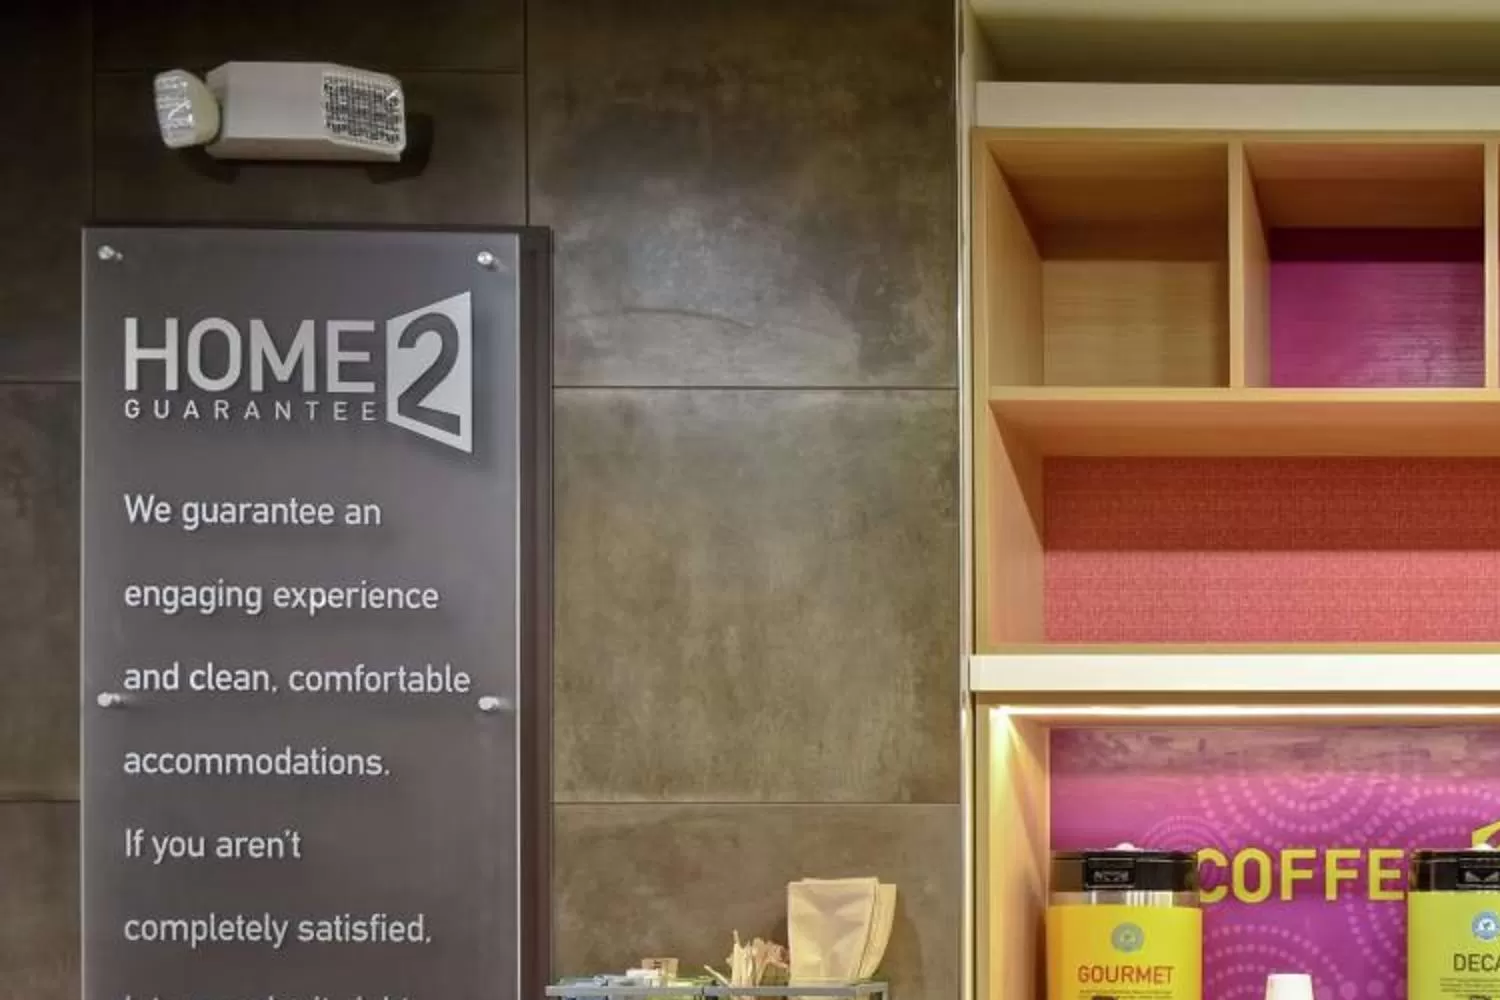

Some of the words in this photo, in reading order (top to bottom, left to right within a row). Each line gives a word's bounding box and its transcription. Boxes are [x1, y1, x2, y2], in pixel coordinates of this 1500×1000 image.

[124, 398, 377, 422] GUARANTEE
[124, 493, 172, 524] We
[181, 497, 335, 532] guarantee
[344, 503, 382, 525] an
[124, 577, 262, 616] engaging
[273, 579, 440, 617] experience
[124, 661, 179, 692] and
[189, 661, 278, 693] clean,
[288, 663, 471, 694] comfortable
[123, 745, 391, 777] accommodations.
[125, 827, 145, 858] If
[152, 835, 205, 866] you
[215, 829, 301, 860] aren't
[1197, 847, 1406, 903] COFFE
[124, 911, 289, 949] completely
[297, 912, 432, 945] satisfied,
[1077, 964, 1175, 985] GOURMET
